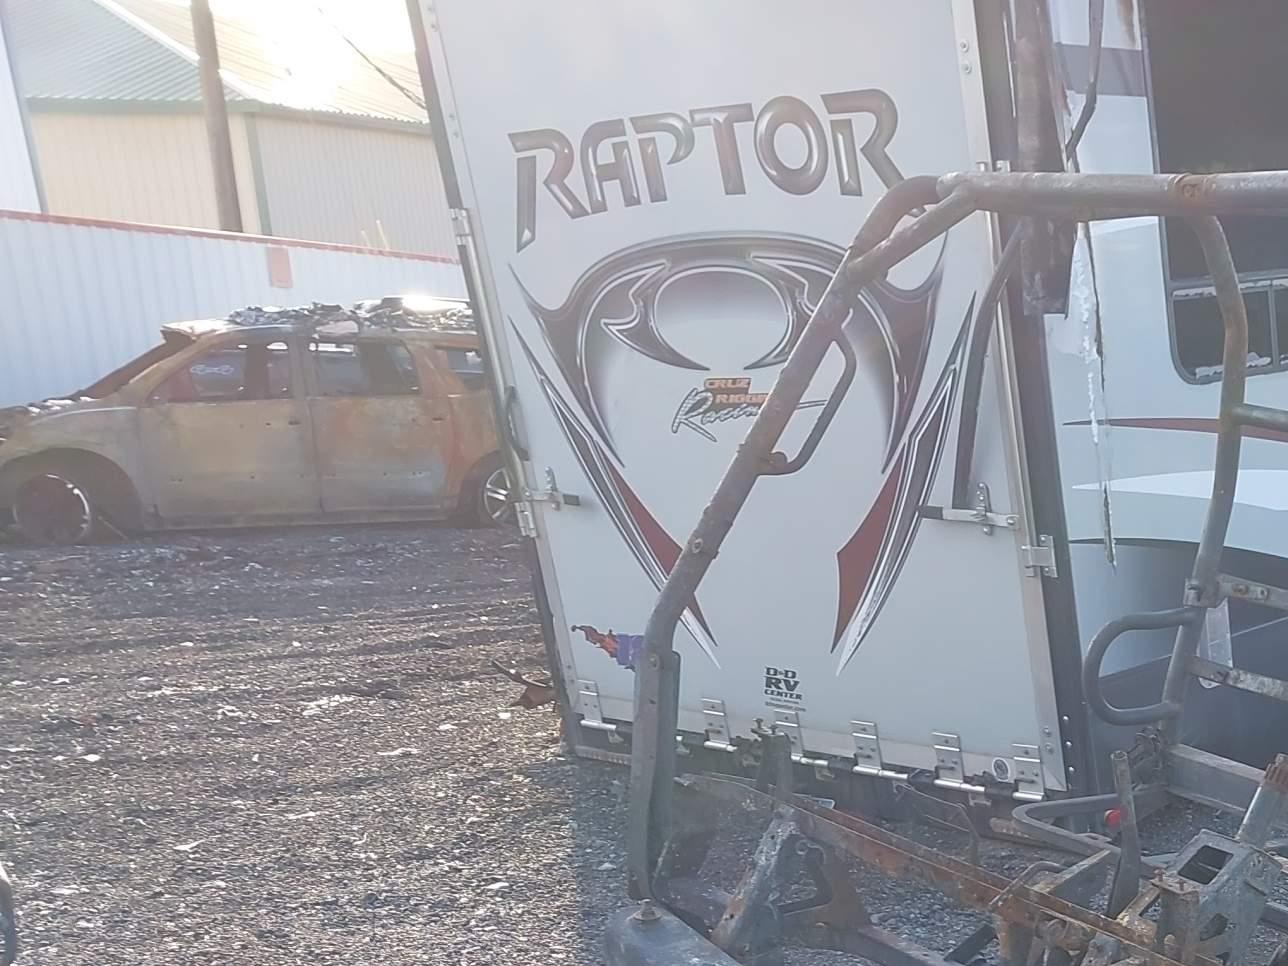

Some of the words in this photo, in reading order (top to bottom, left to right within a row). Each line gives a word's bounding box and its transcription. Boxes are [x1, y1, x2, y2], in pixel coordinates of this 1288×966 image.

[507, 88, 927, 254] RAPTOR
[671, 387, 766, 442] Racin
[764, 676, 800, 691] RV
[764, 688, 803, 701] CENTER
